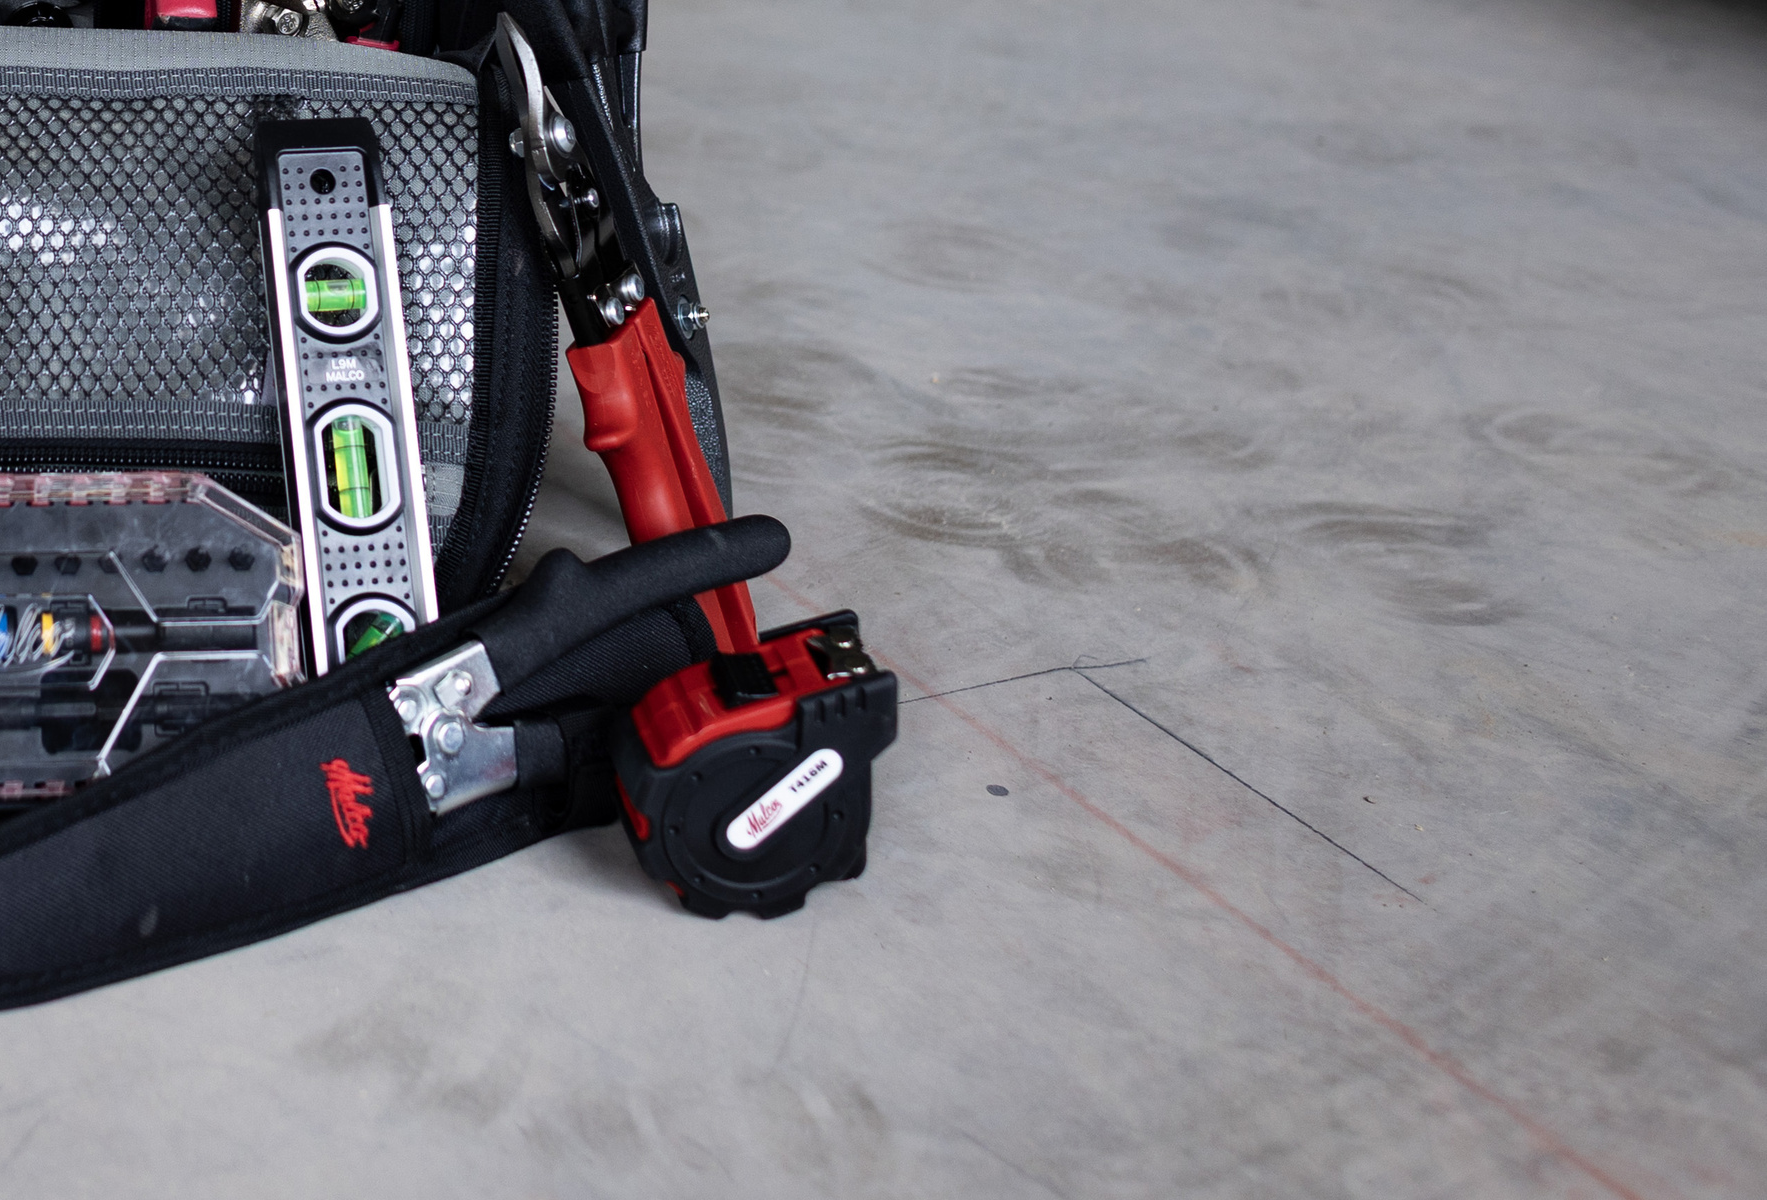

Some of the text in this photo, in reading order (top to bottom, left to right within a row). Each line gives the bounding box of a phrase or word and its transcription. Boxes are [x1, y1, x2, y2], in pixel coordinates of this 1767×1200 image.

[325, 369, 365, 382] MALCO
[331, 358, 357, 370] L9M
[319, 757, 374, 849] Malco
[746, 798, 783, 839] Malco
